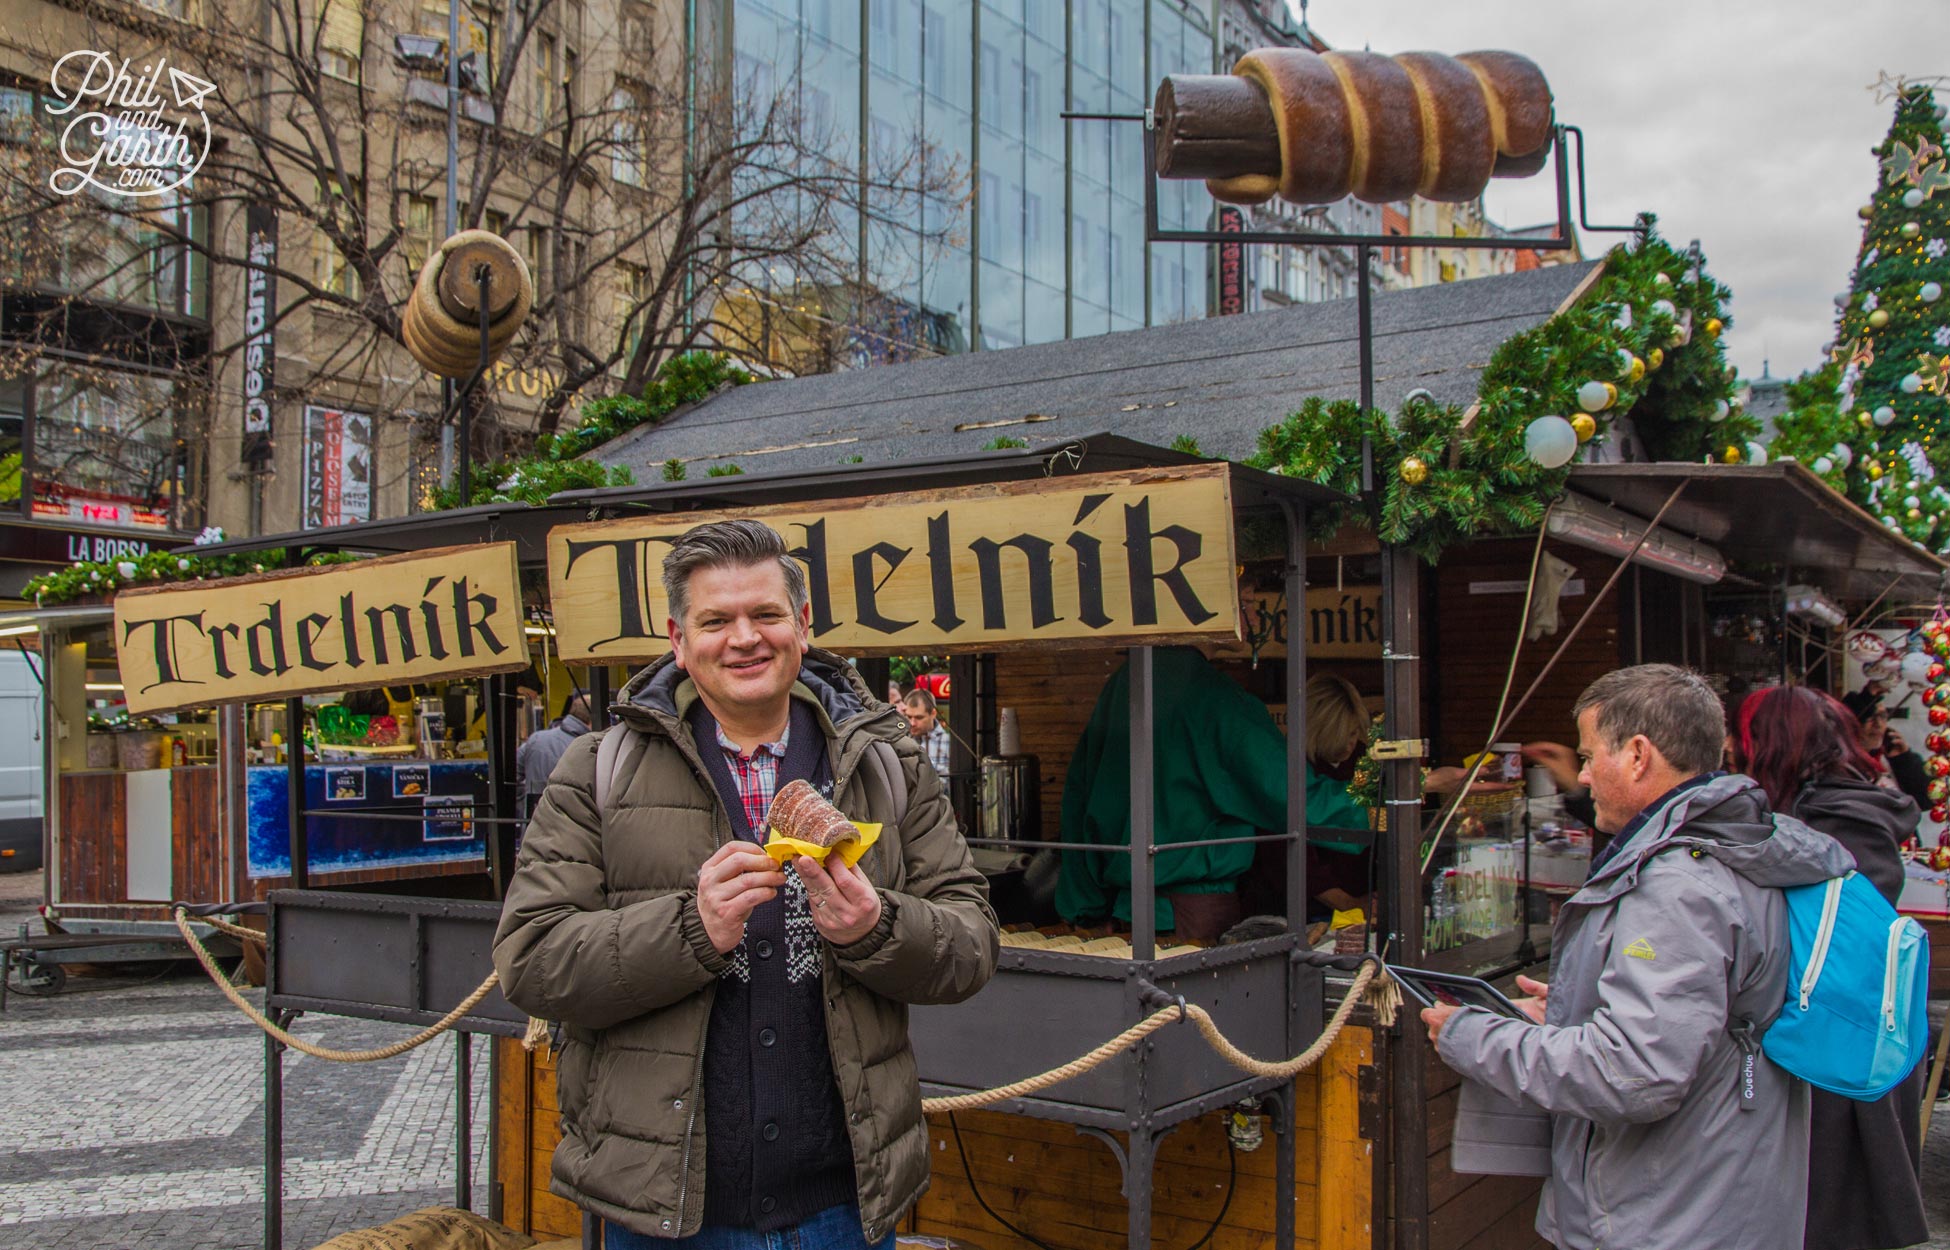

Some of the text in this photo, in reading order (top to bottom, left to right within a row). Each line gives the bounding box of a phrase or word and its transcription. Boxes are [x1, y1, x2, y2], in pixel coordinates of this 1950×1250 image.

[310, 441, 323, 525] PIZZA
[68, 535, 150, 563] LA BORSA
[565, 492, 1219, 653] Tdelník
[123, 575, 509, 694] Trdelník
[1744, 1054, 1754, 1099] Quechua
